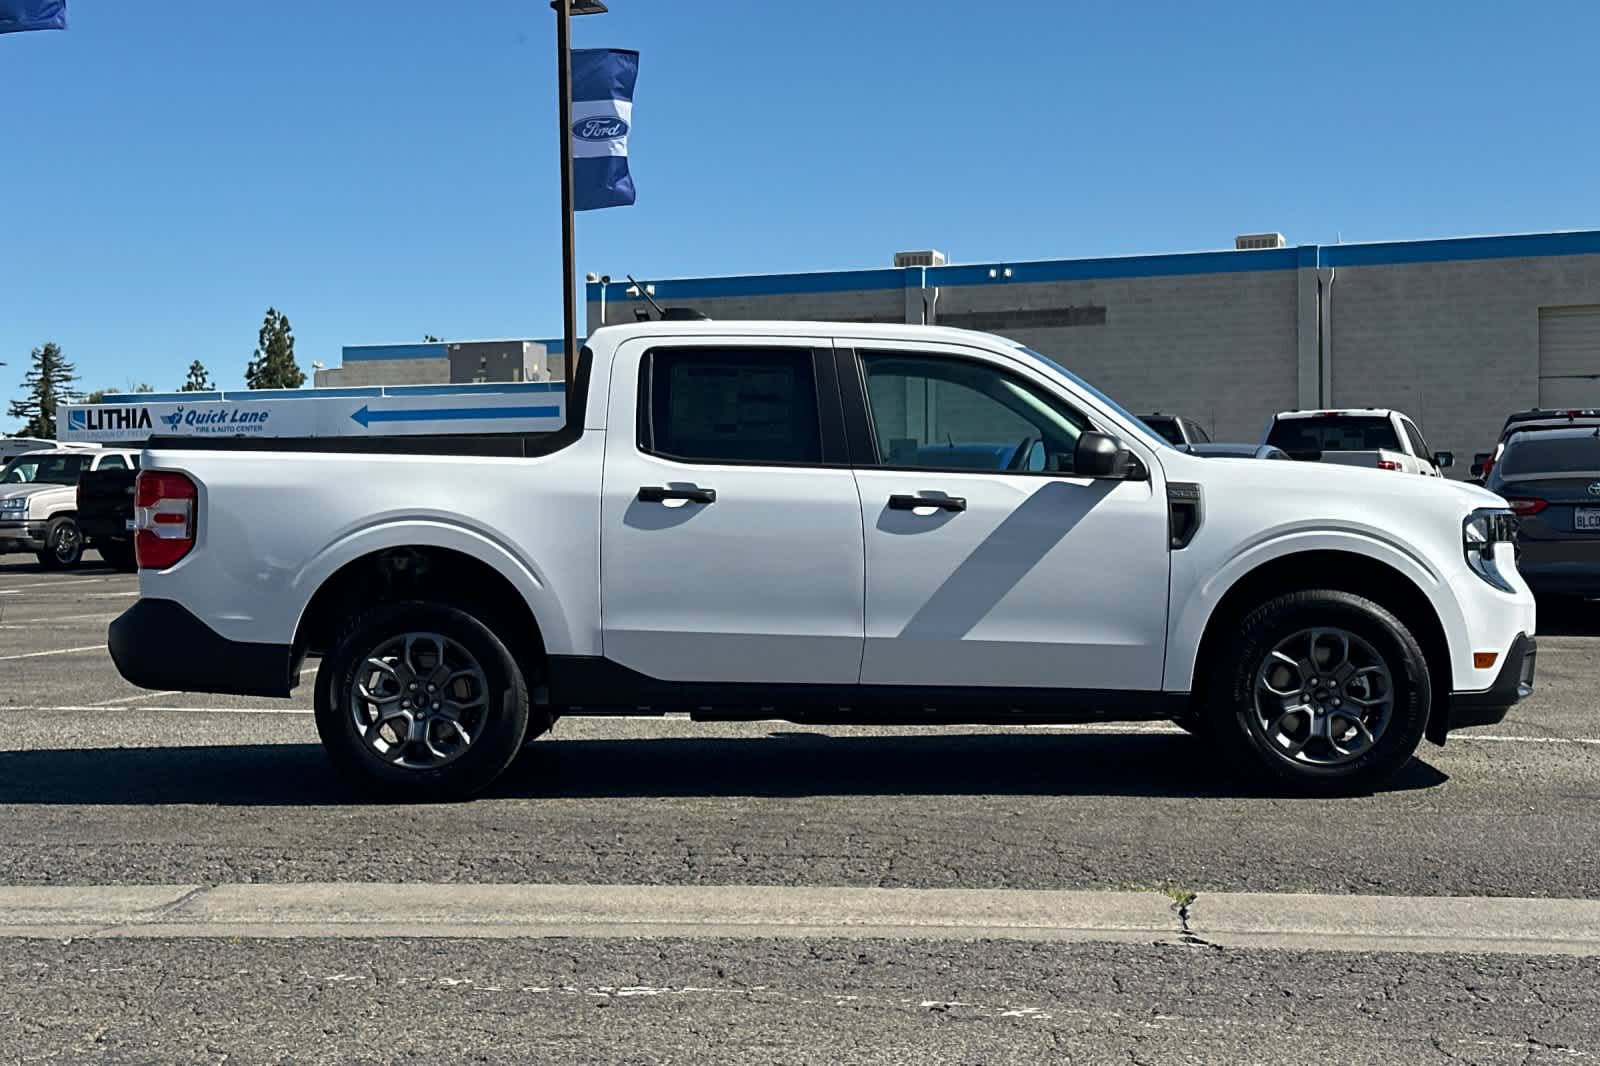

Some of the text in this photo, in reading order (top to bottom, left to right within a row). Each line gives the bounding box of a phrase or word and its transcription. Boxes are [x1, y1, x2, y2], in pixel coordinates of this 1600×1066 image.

[582, 120, 620, 137] Ford
[87, 408, 152, 430] LITHIA
[185, 409, 269, 426] Quick Lane
[195, 425, 209, 433] TIRE
[217, 425, 235, 433] AUTO
[235, 425, 263, 433] CENTER
